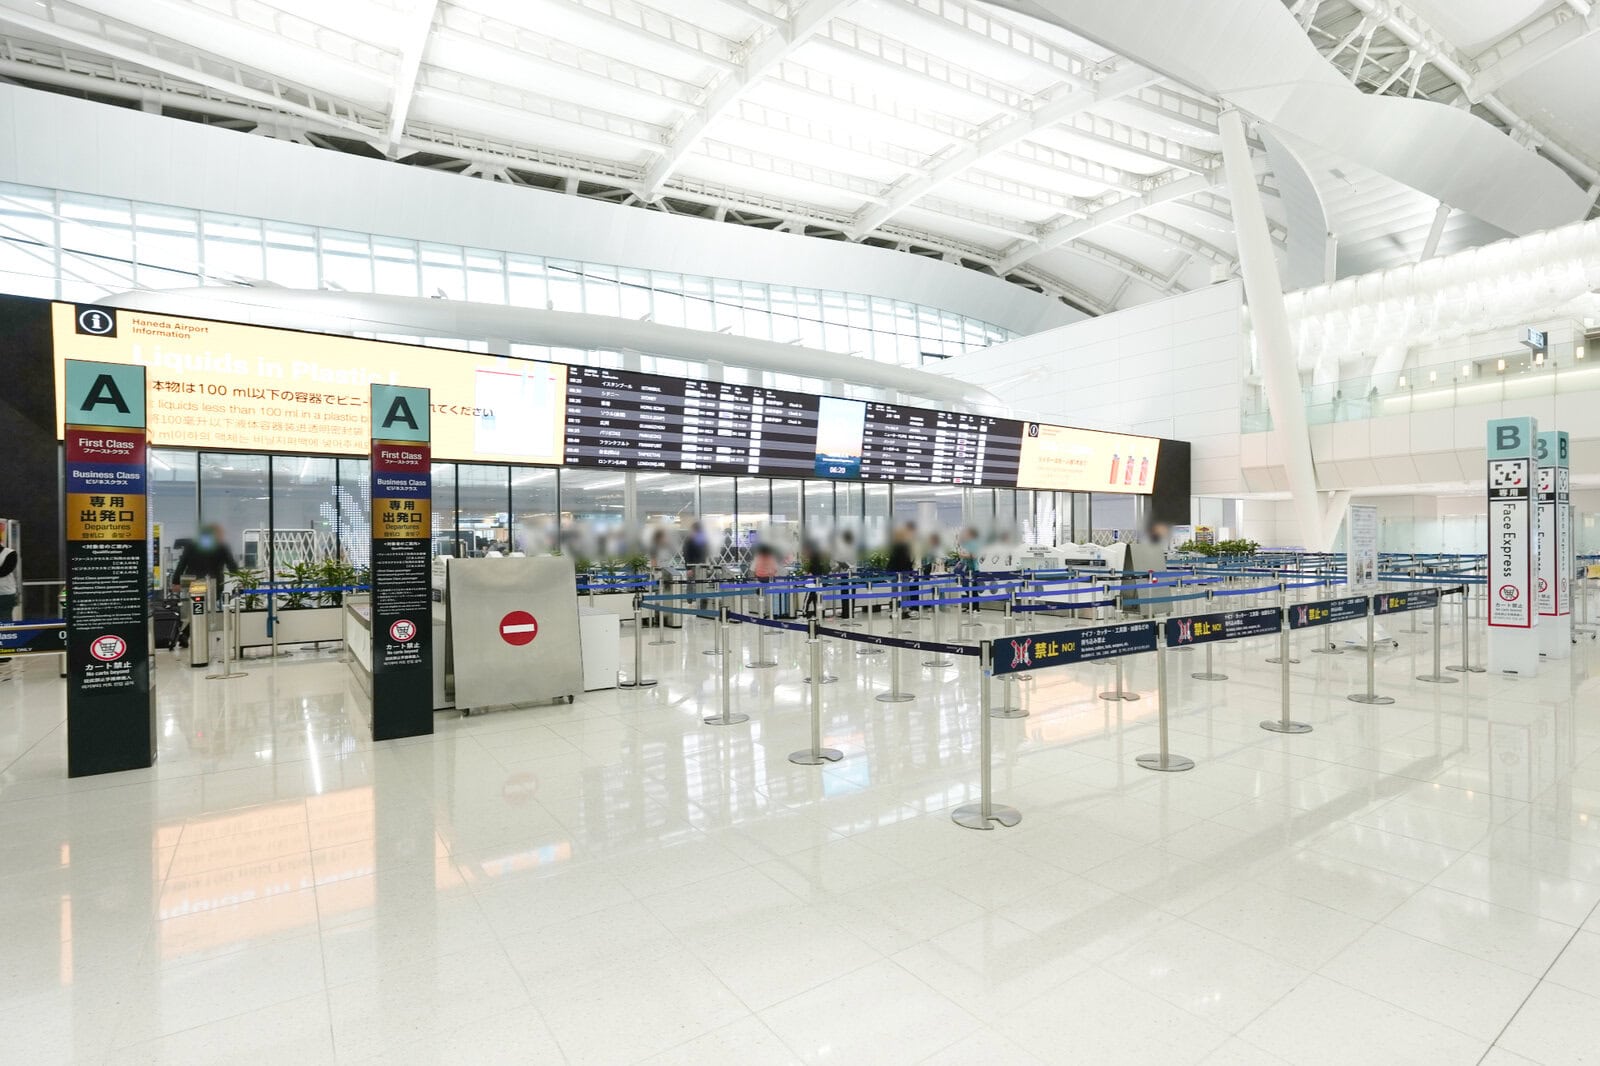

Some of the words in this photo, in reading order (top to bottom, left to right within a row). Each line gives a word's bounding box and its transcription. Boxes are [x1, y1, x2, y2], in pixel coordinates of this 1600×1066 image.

[132, 318, 172, 330] Haneda
[174, 321, 209, 334] Airport
[132, 327, 190, 340] Information
[131, 342, 249, 374] Liquids
[258, 356, 282, 378] in
[80, 374, 131, 414] A
[158, 399, 199, 412] liquids
[202, 403, 226, 414] less
[229, 404, 256, 415] than
[261, 407, 282, 416] 100
[324, 411, 357, 423] plastic
[382, 396, 419, 430] A
[78, 438, 102, 448] First
[106, 439, 134, 450] Class
[1496, 425, 1521, 450] B
[381, 450, 400, 459] First
[401, 452, 422, 460] Class
[1560, 438, 1568, 460] B
[72, 470, 114, 479] Business
[116, 471, 140, 480] Class
[1499, 488, 1518, 497] 専用
[90, 496, 125, 508] 専用
[389, 500, 415, 511] 専用
[80, 510, 134, 522] 出発口
[382, 512, 422, 523] 出発口
[1503, 504, 1516, 530] Face
[84, 523, 131, 532] Departures
[1500, 532, 1516, 578] Express
[194, 603, 202, 612] 2
[1194, 622, 1211, 636] 禁止
[1034, 641, 1059, 659] 禁止
[1061, 642, 1075, 652] NO!
